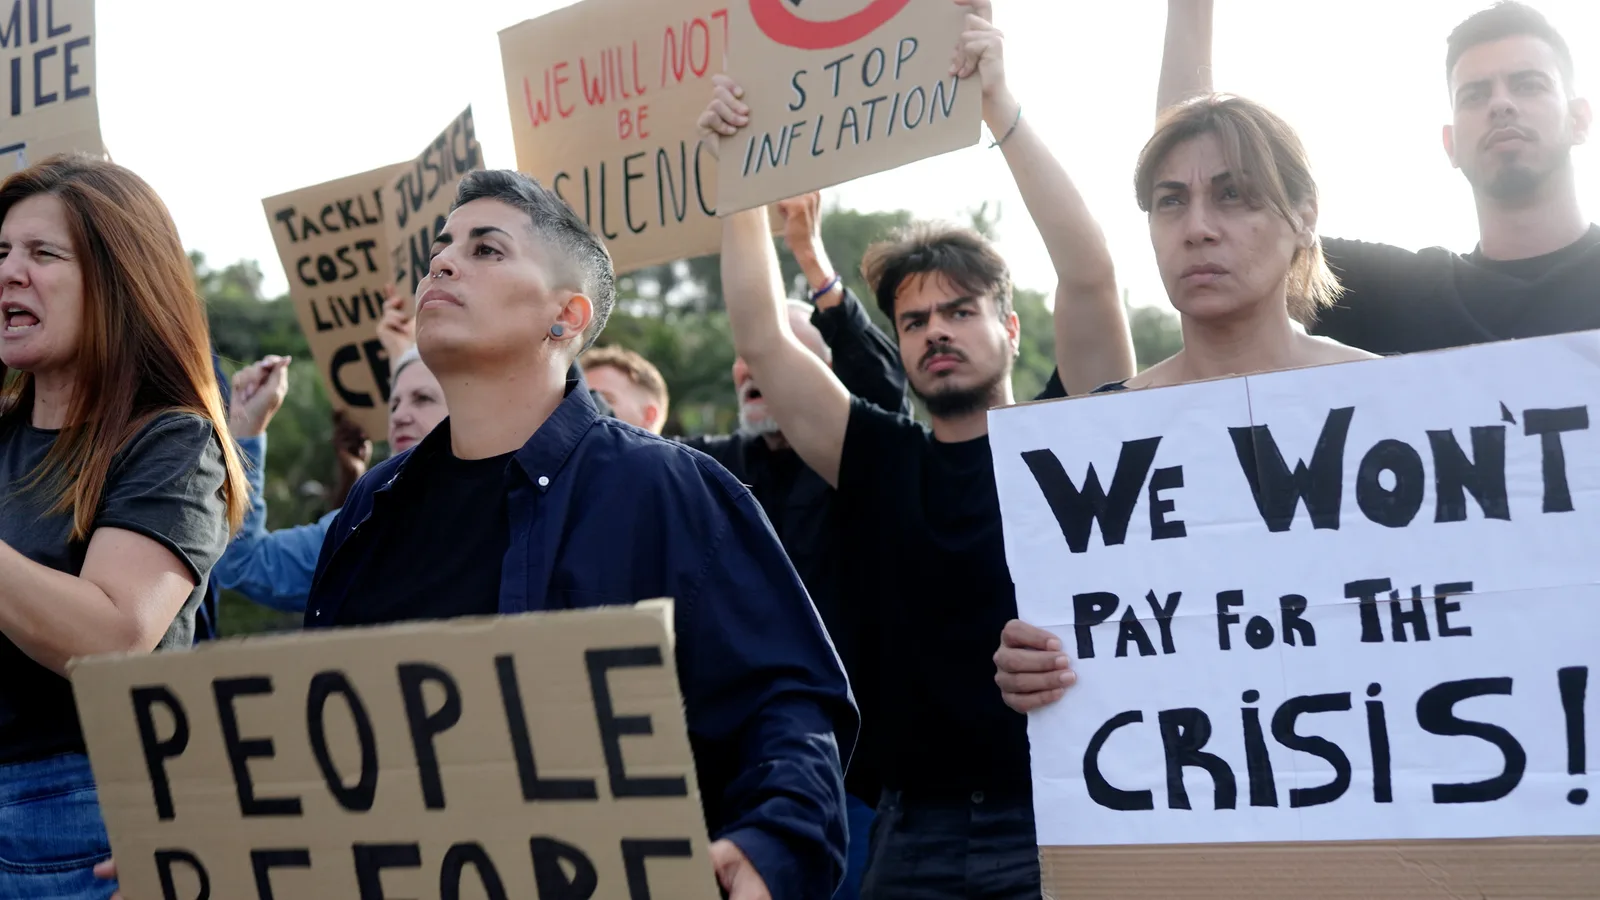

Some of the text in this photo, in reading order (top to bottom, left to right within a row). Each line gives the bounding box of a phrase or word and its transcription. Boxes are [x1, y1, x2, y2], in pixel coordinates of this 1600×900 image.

[11, 35, 91, 117] ICE
[523, 8, 728, 128] WE WILL NOT
[788, 36, 919, 112] STOP
[617, 104, 650, 141] BE
[741, 74, 959, 177] INFLATION
[296, 239, 376, 287] COST
[1020, 401, 1589, 554] WE WON'T
[1072, 577, 1474, 660] PAY FOR THE
[129, 645, 689, 821] PEOPLE
